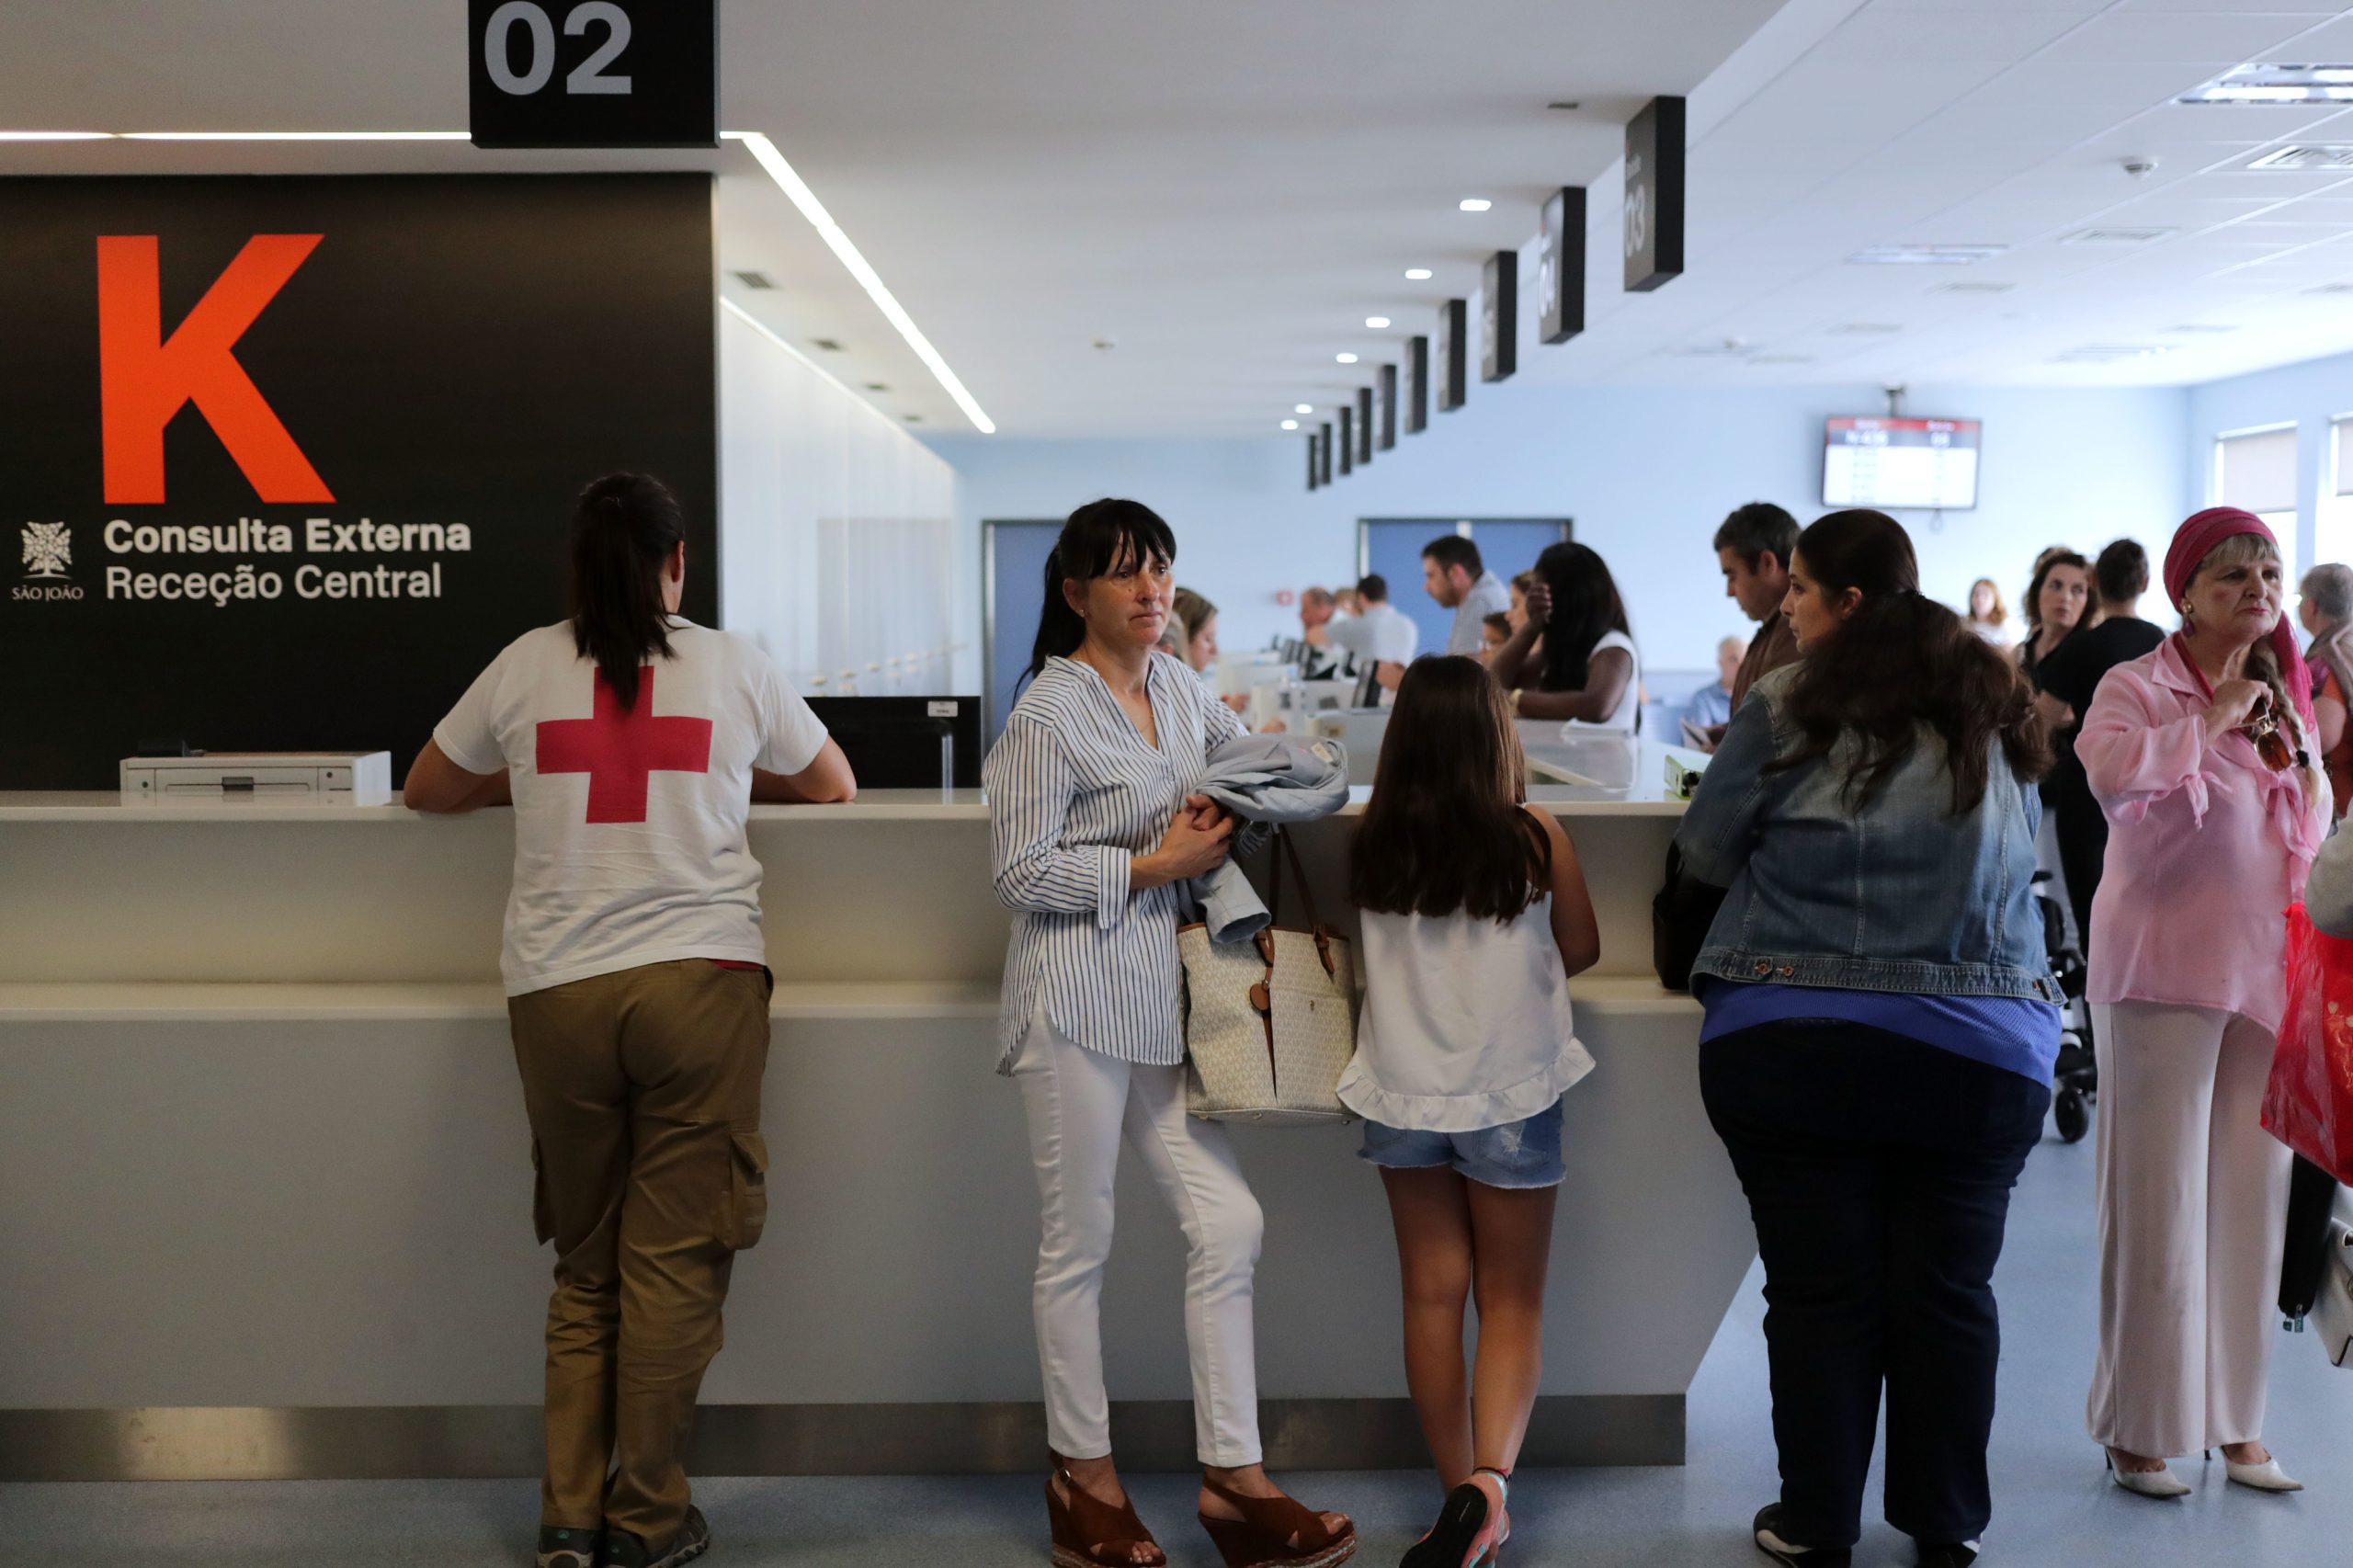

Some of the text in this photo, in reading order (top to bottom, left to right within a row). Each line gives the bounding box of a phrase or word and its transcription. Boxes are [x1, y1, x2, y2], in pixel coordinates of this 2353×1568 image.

[484, 1, 632, 97] 02
[97, 233, 336, 504] K
[104, 517, 472, 553] Consulta Externa
[11, 585, 85, 602] SÃO JOÃO
[107, 562, 441, 608] Receção Central
